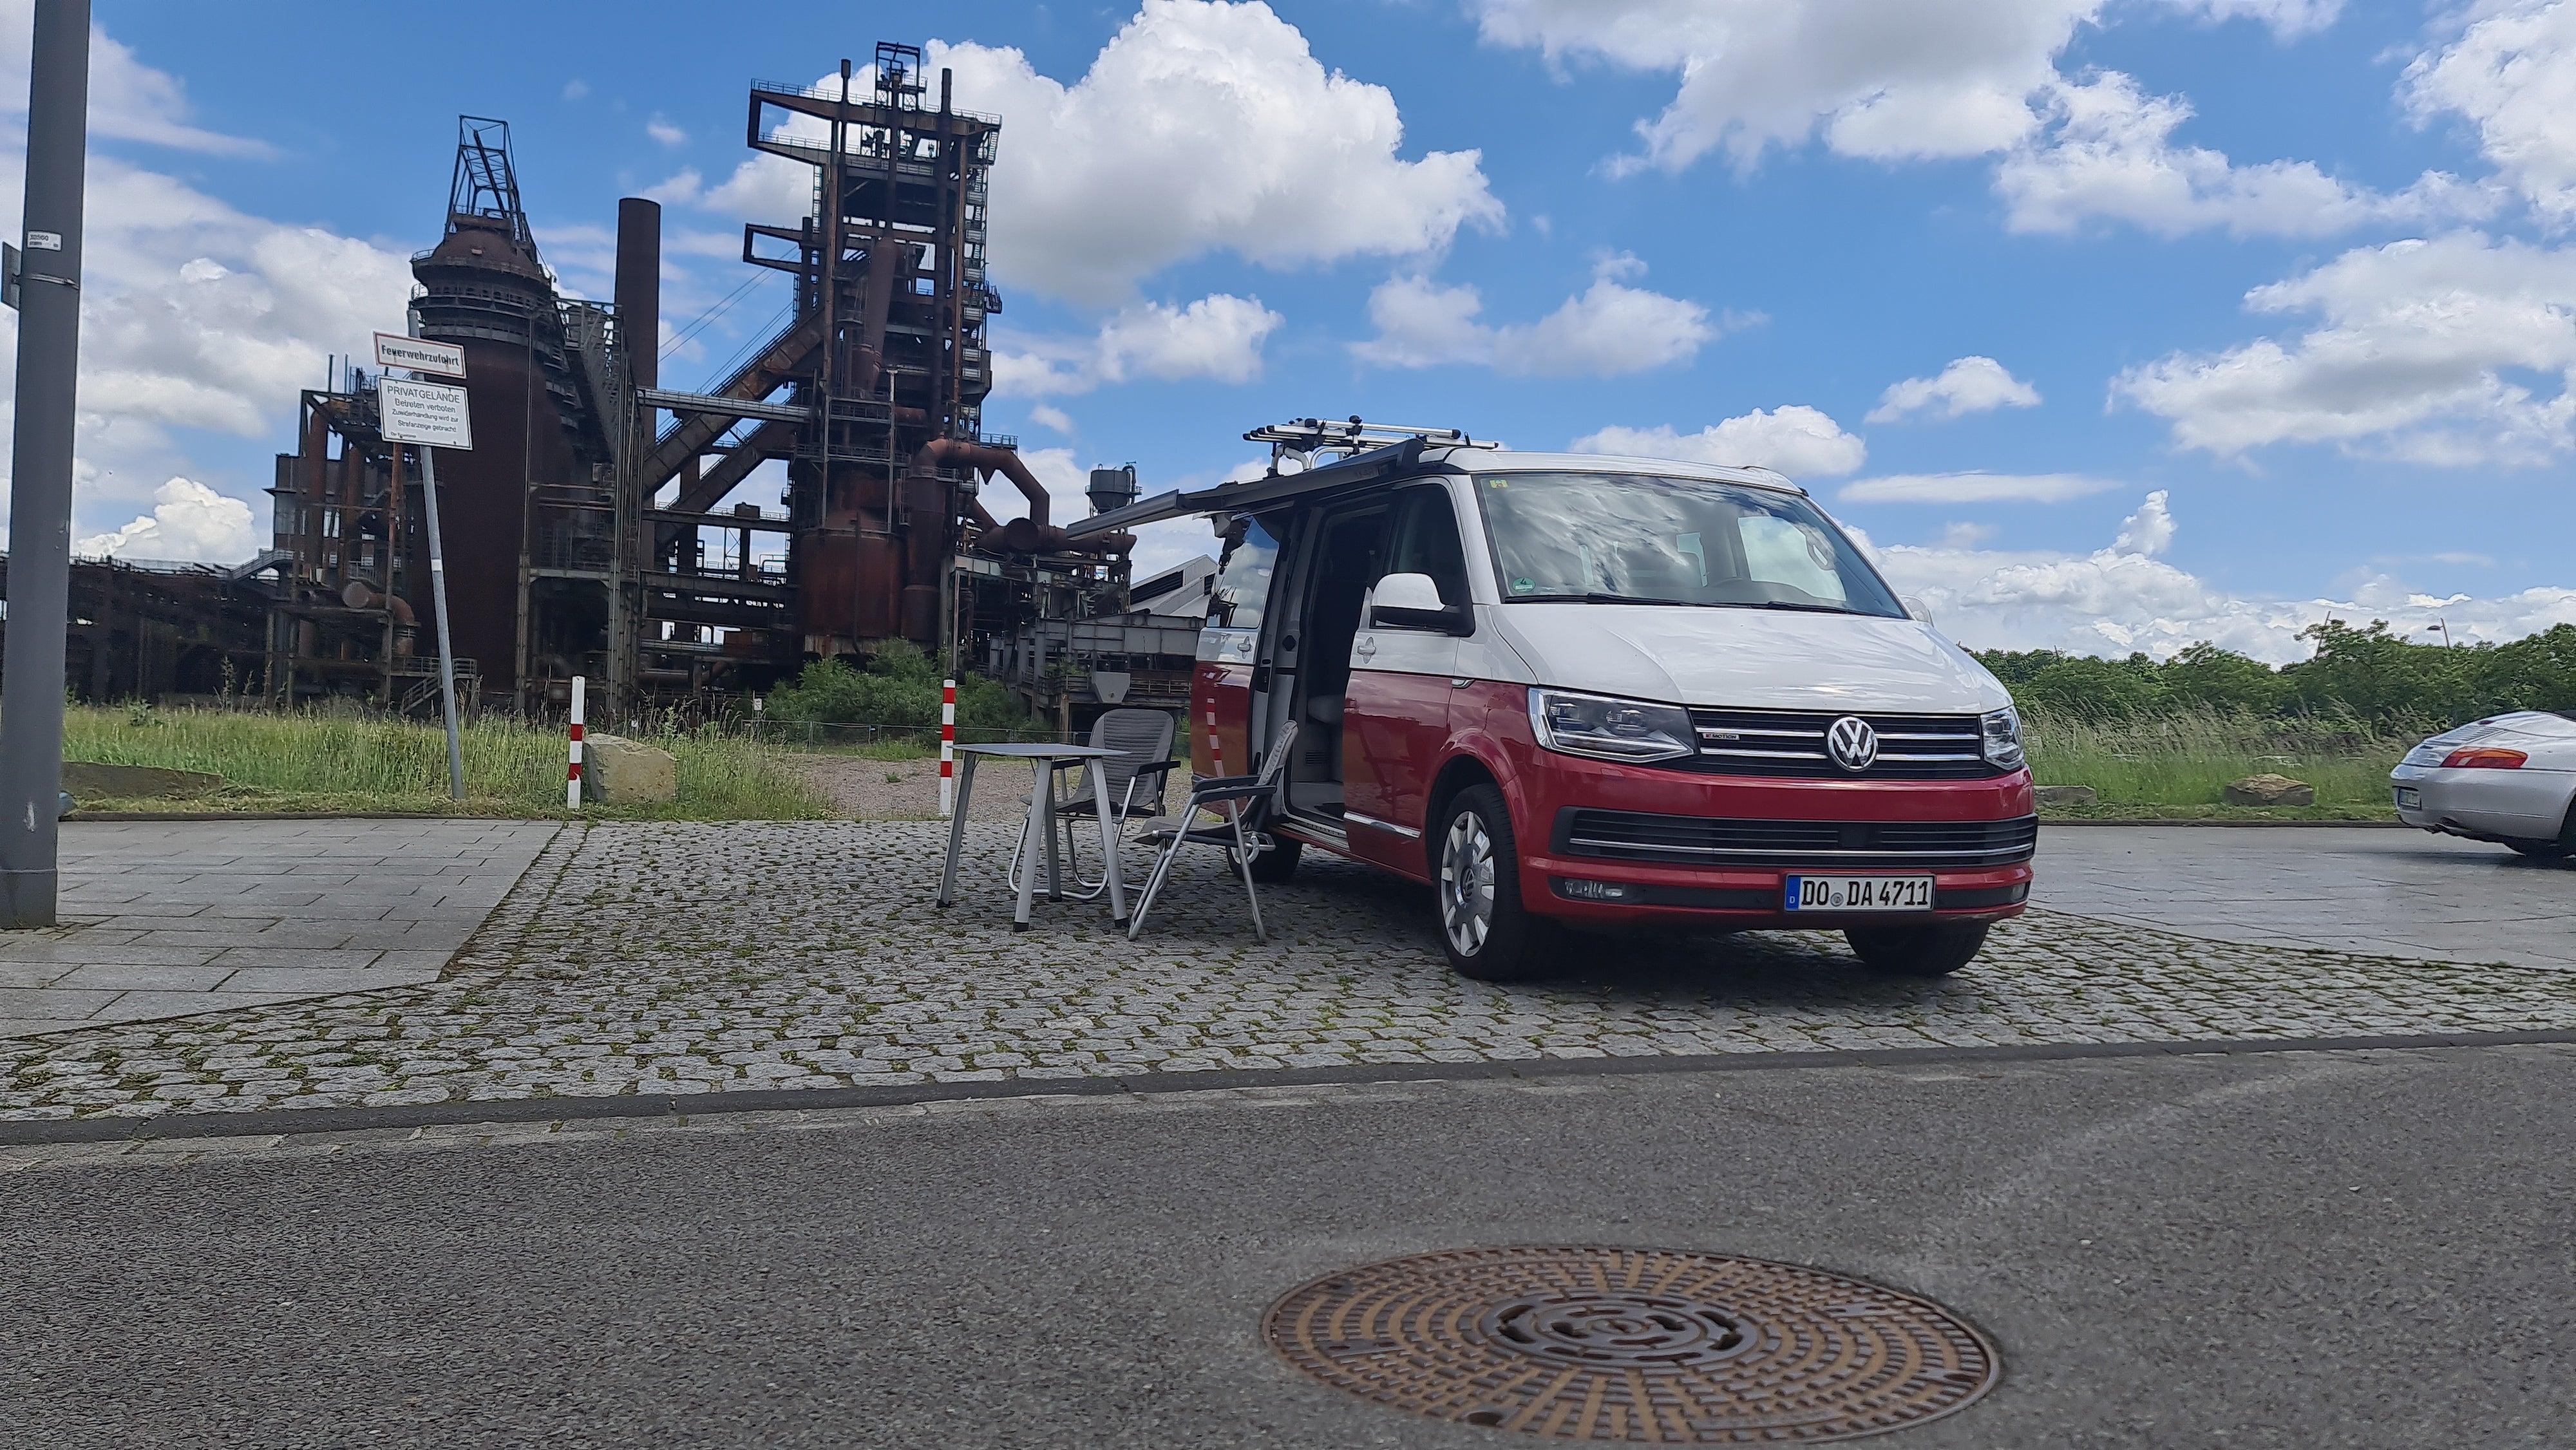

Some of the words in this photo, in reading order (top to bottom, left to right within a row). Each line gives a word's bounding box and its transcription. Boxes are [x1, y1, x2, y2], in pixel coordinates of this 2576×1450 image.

[381, 344, 460, 366] Feuerwehrzufahrt
[387, 385, 460, 404] PRIVATGELÄNDE
[395, 398, 424, 409] Betreten
[427, 404, 456, 413] verboten
[1789, 896, 1795, 904] D
[1801, 880, 1829, 905] DO
[1846, 881, 1873, 906] DA
[1879, 881, 1929, 906] 4711
